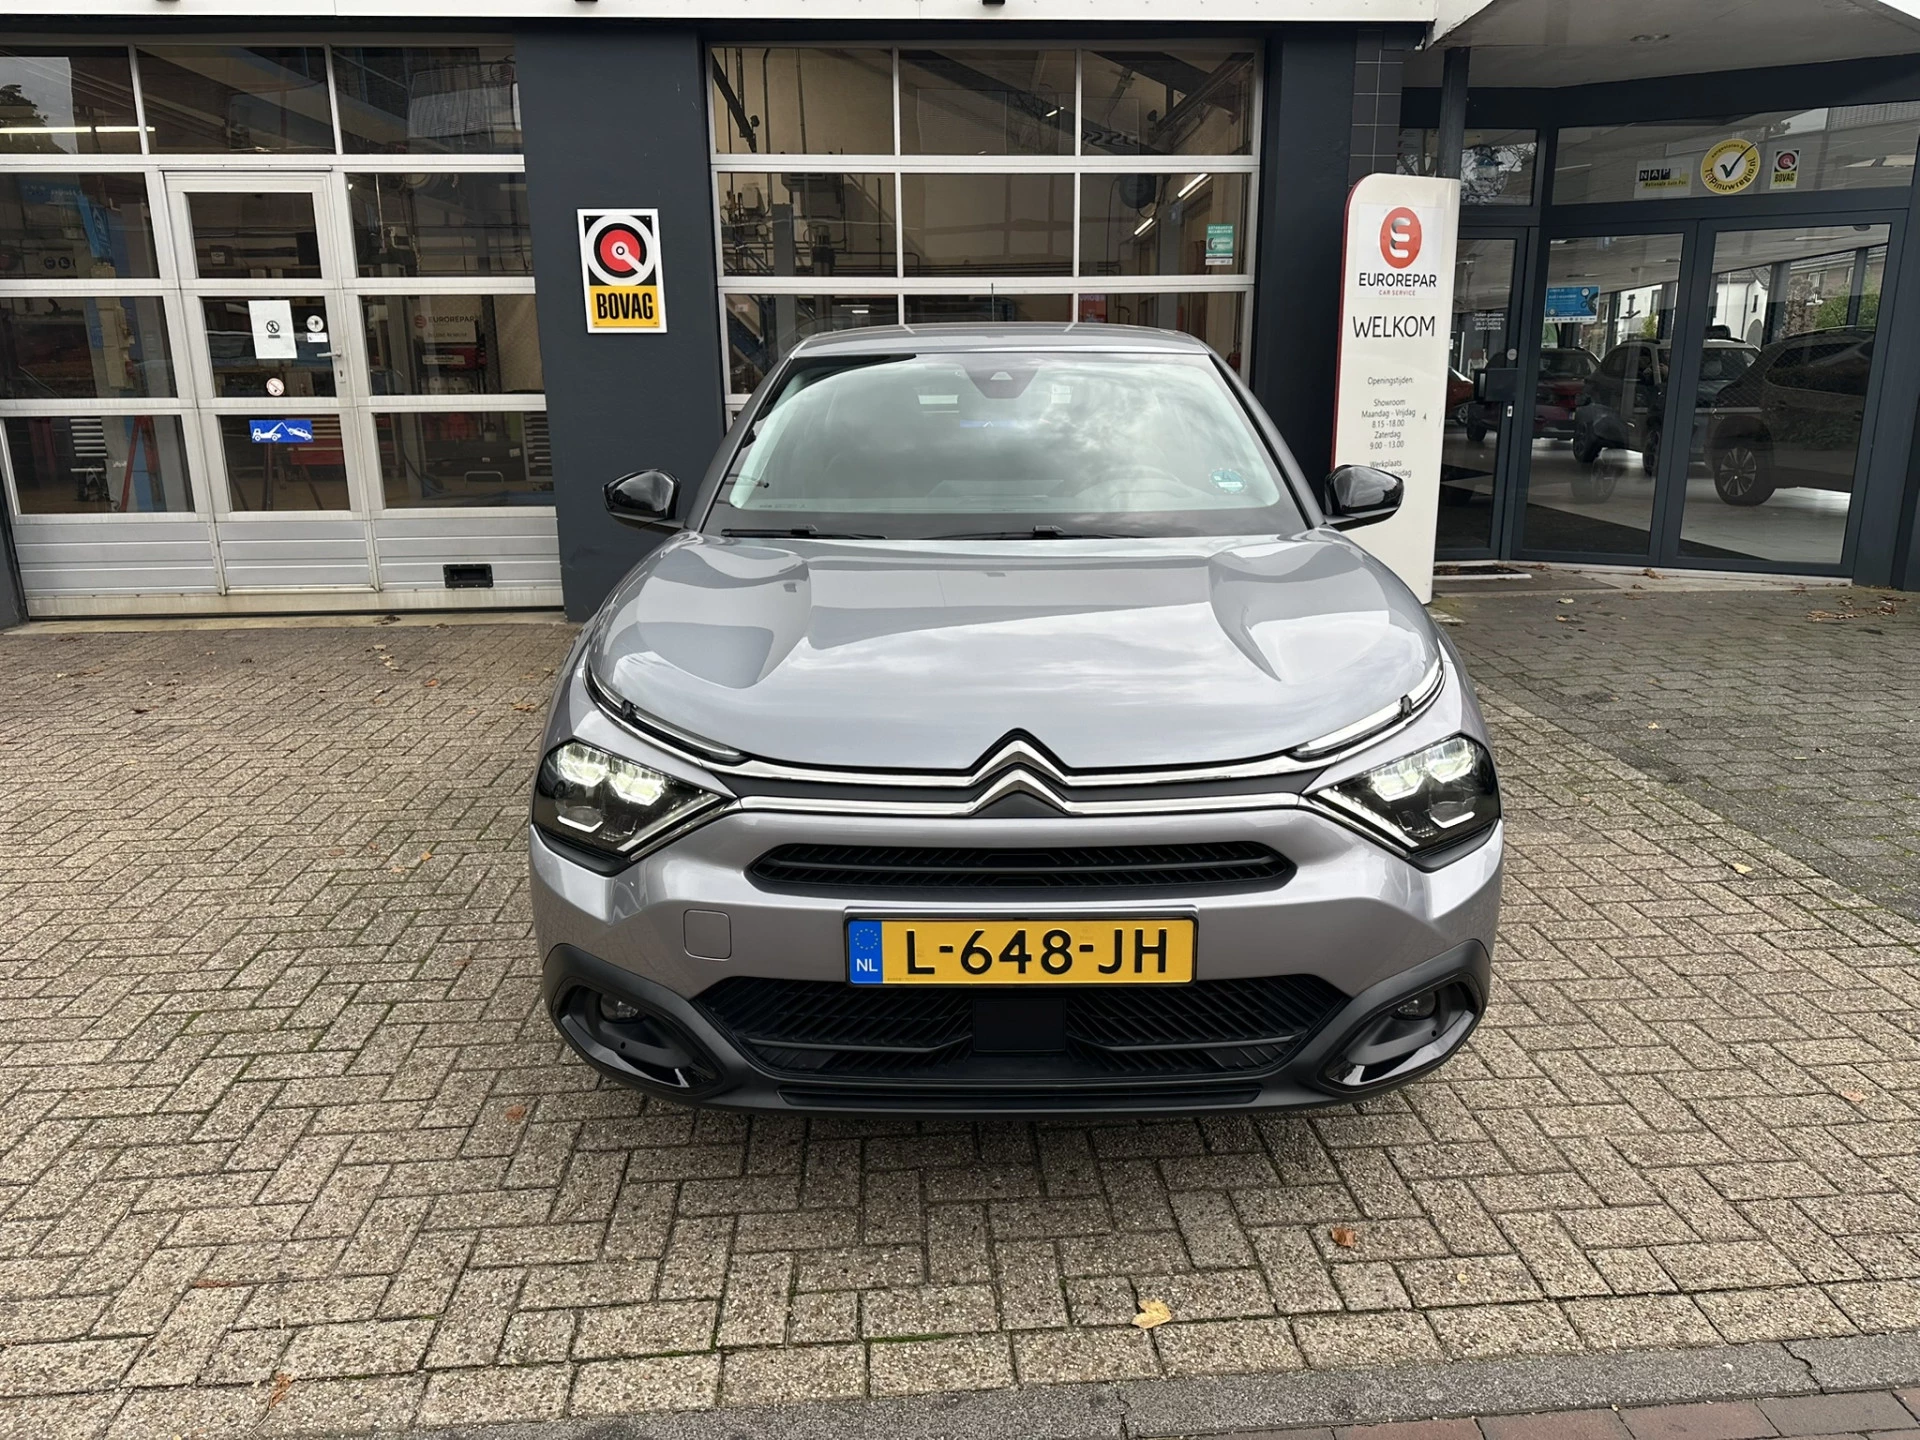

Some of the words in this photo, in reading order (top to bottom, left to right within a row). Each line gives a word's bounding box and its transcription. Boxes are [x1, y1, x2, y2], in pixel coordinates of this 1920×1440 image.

[1640, 168, 1670, 180] NAP
[1774, 172, 1795, 182] BOVAG
[1358, 272, 1437, 287] EUROREPAR
[596, 293, 654, 319] BOVAG
[1352, 315, 1436, 338] WELKOM
[1373, 398, 1406, 407] Showroom
[1361, 410, 1390, 419] Maandag
[1395, 408, 1416, 418] Vrijdag
[1374, 430, 1401, 440] Zaterdag
[1369, 441, 1383, 450] 9.00
[1388, 440, 1405, 448] 13.00
[1369, 460, 1402, 469] Werkplaats
[906, 928, 1168, 976] L-648-JH
[856, 958, 879, 972] NL
